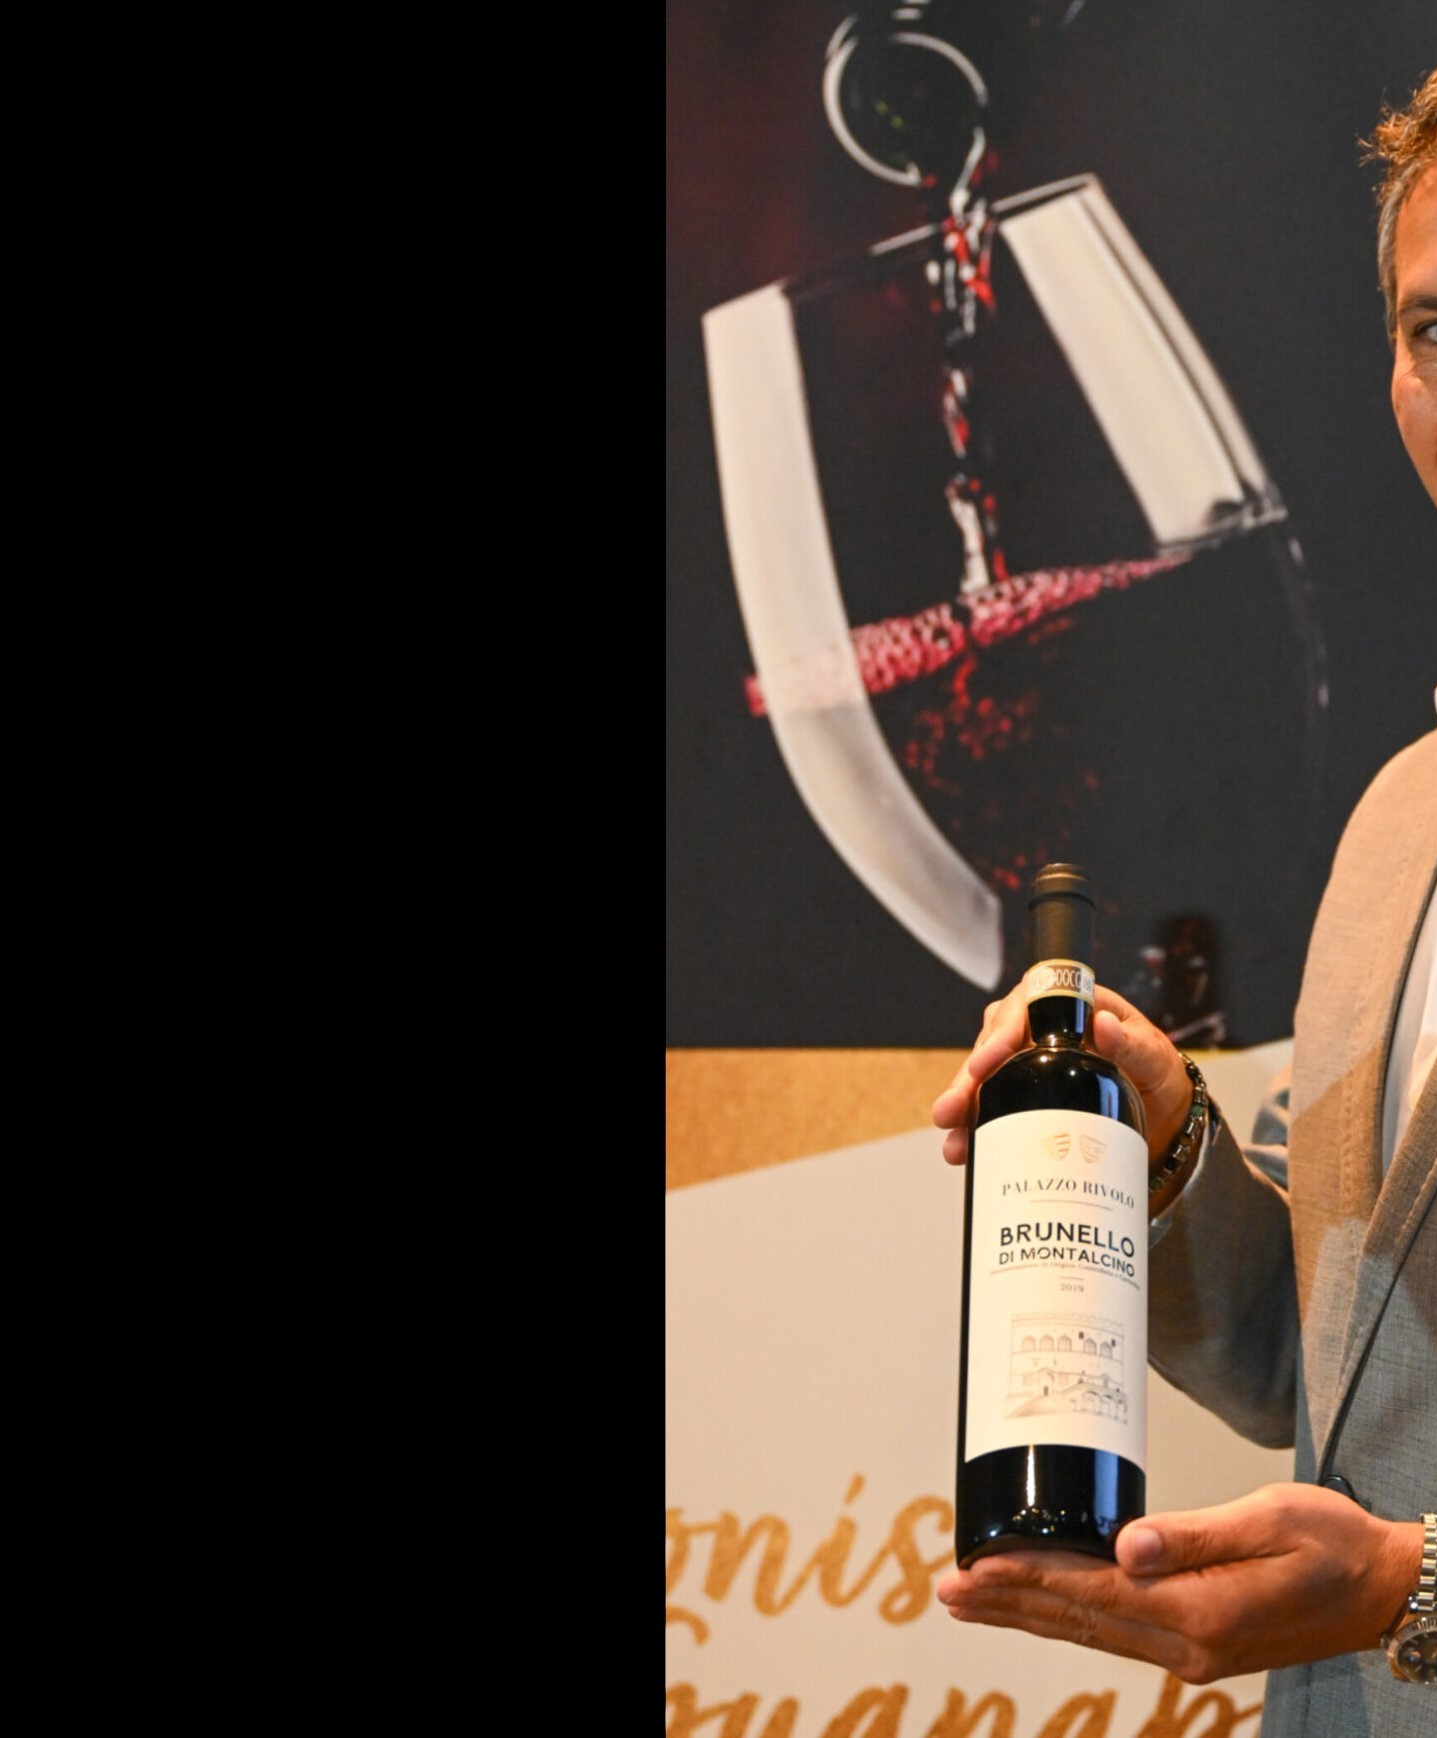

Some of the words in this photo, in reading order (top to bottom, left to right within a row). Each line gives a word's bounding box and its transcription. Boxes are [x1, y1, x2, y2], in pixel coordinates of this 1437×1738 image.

[1002, 1178, 1077, 1197] PALAZZO
[1083, 1180, 1135, 1209] RIVOLO
[1000, 1222, 1135, 1258] BRUNELLO
[998, 1251, 1015, 1265] DI
[1020, 1247, 1135, 1278] MONTALCINO
[1060, 1283, 1085, 1293] 2019
